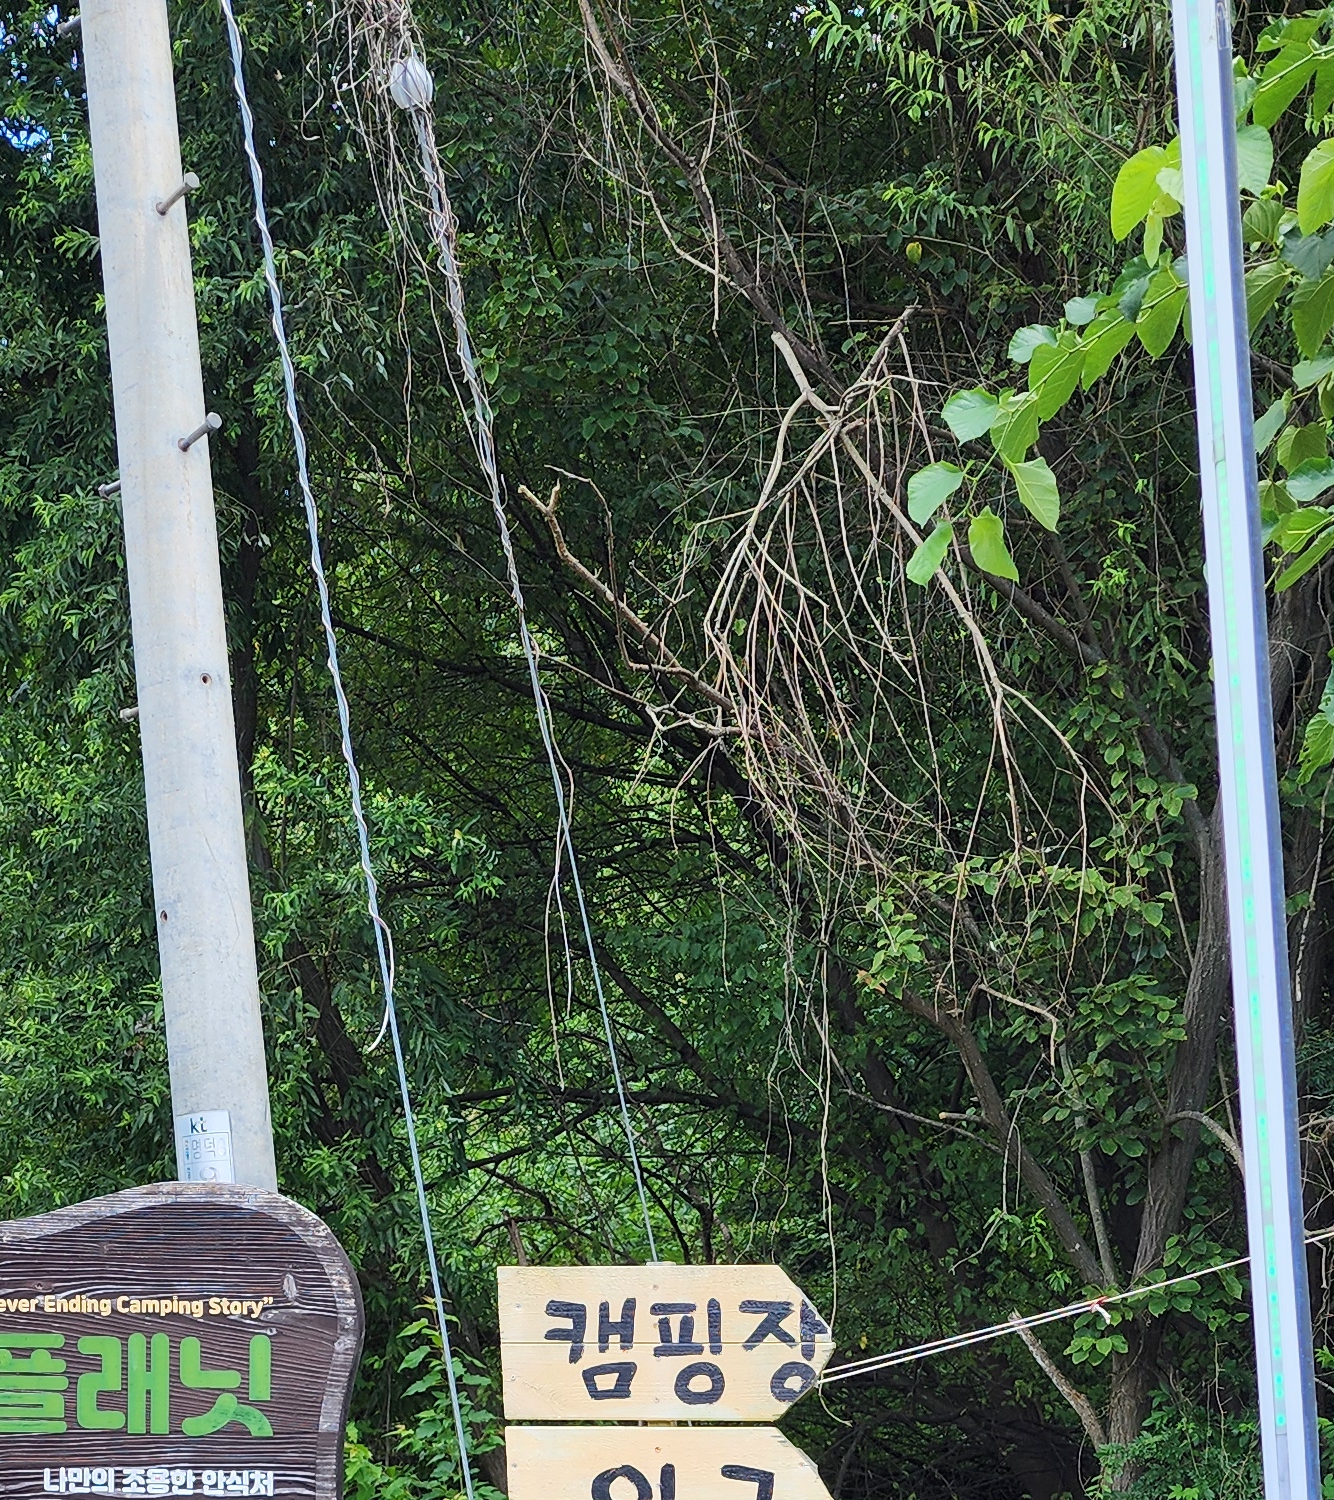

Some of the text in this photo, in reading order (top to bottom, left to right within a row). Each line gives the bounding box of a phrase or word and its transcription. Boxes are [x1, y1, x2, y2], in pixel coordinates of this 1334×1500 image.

[44, 1294, 112, 1317] Ending
[117, 1295, 203, 1318] Camping
[544, 1297, 832, 1405] 캠핑장
[43, 1467, 274, 1497] 나만의 조용한 안식처
